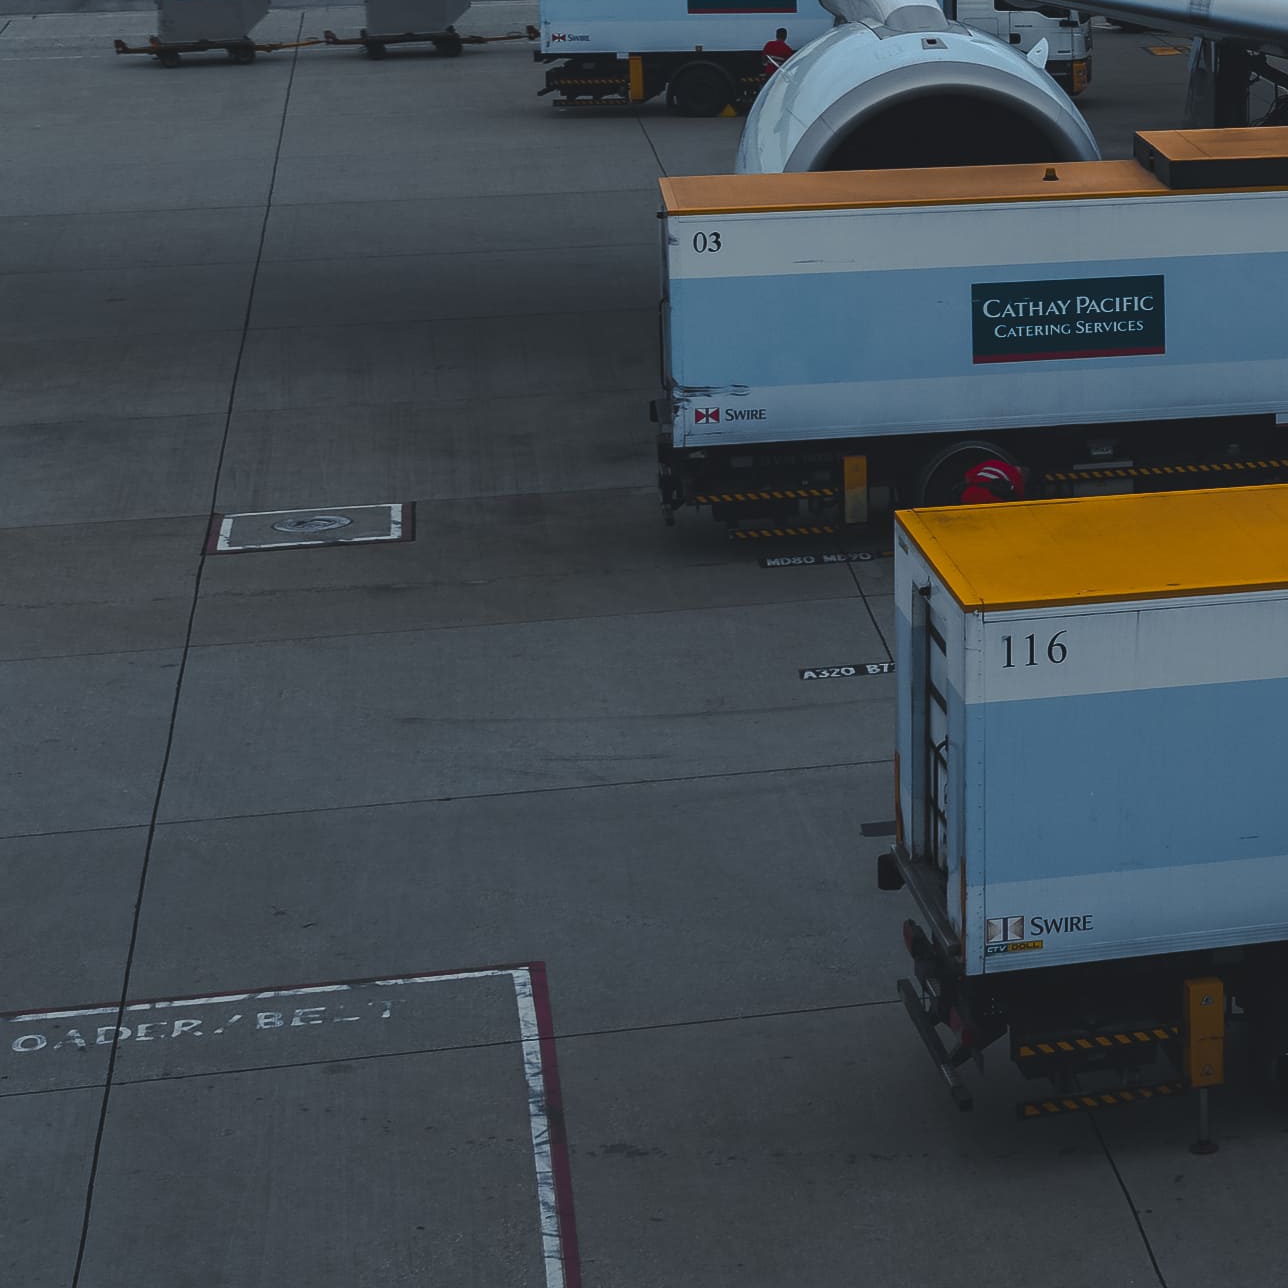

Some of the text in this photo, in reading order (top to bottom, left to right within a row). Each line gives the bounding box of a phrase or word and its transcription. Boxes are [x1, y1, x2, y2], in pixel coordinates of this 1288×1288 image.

[693, 231, 722, 253] 03
[982, 295, 1154, 318] CATHAY PACIFIC
[993, 319, 1144, 338] CATERING SERVICES
[725, 408, 767, 422] SWIRE
[767, 555, 816, 567] MD80
[1001, 629, 1067, 668] 116
[803, 667, 856, 680] A320
[1030, 915, 1094, 936] SWIRE
[987, 944, 1007, 953] CTV
